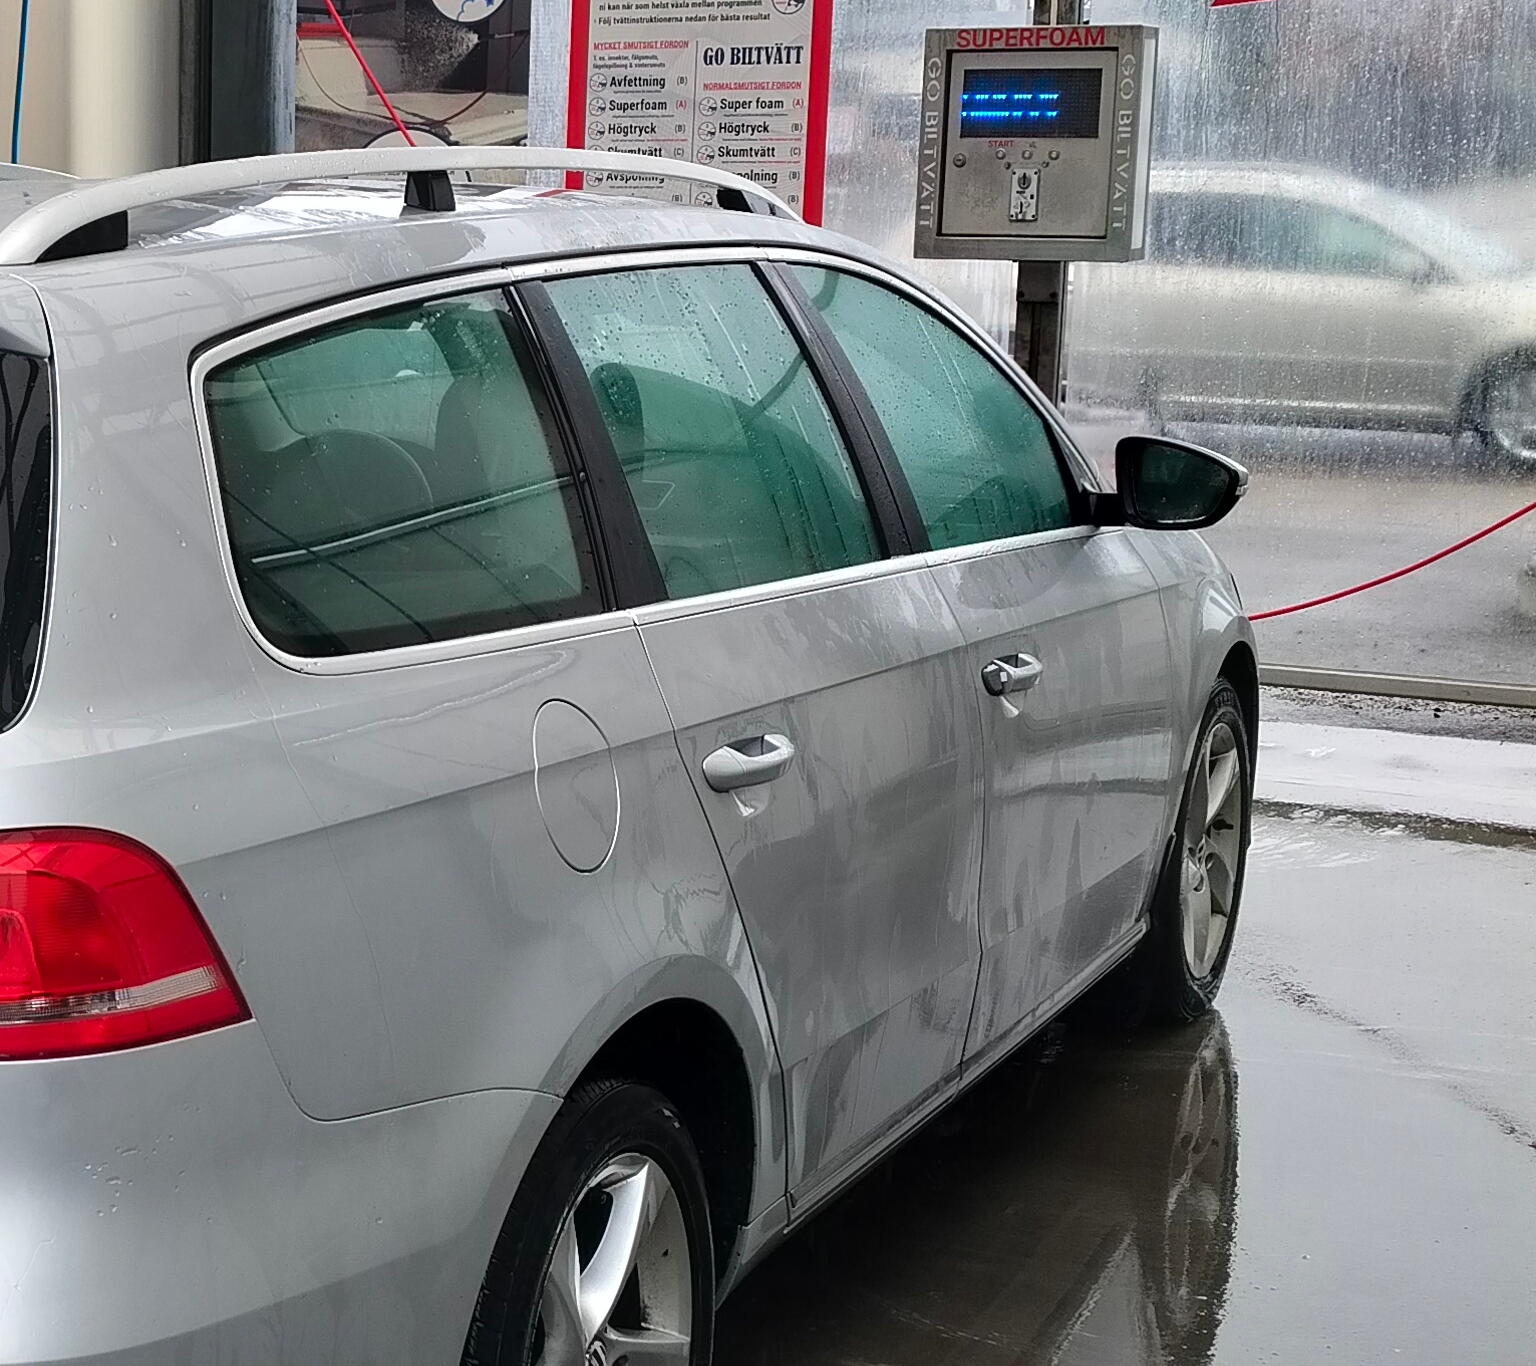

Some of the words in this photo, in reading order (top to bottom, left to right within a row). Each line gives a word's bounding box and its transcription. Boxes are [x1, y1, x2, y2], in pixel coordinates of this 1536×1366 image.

[599, 3, 606, 11] ni
[607, 3, 621, 11] kan
[622, 2, 634, 11] när
[635, 2, 650, 10] som
[670, 0, 690, 10] växla
[691, 0, 715, 9] mellan
[717, 0, 762, 9] programmen
[598, 17, 612, 27] Följ
[613, 15, 683, 25] tvättinstruktionerna
[684, 14, 706, 23] nedan
[708, 13, 719, 22] för
[720, 13, 740, 22] bästa
[742, 12, 770, 21] resultat
[956, 27, 1105, 48] SUPERFOAM
[594, 41, 622, 51] MYCKET
[623, 41, 658, 50] SMUTSIGT
[660, 40, 689, 49] FORDON
[703, 46, 724, 66] GO
[729, 43, 804, 65] BILTVÄTT
[610, 75, 666, 89] Avfettning
[926, 57, 942, 102] GO
[1120, 53, 1136, 100] GO
[703, 82, 770, 91] NORMALSMUTSIGT
[772, 81, 802, 90] FORDON
[609, 99, 667, 113] Superfoam
[720, 98, 752, 112] Super
[756, 97, 784, 109] foam
[608, 122, 657, 137] Högtryck
[719, 121, 770, 136] Högtryck
[718, 146, 775, 157] Skumtvätt
